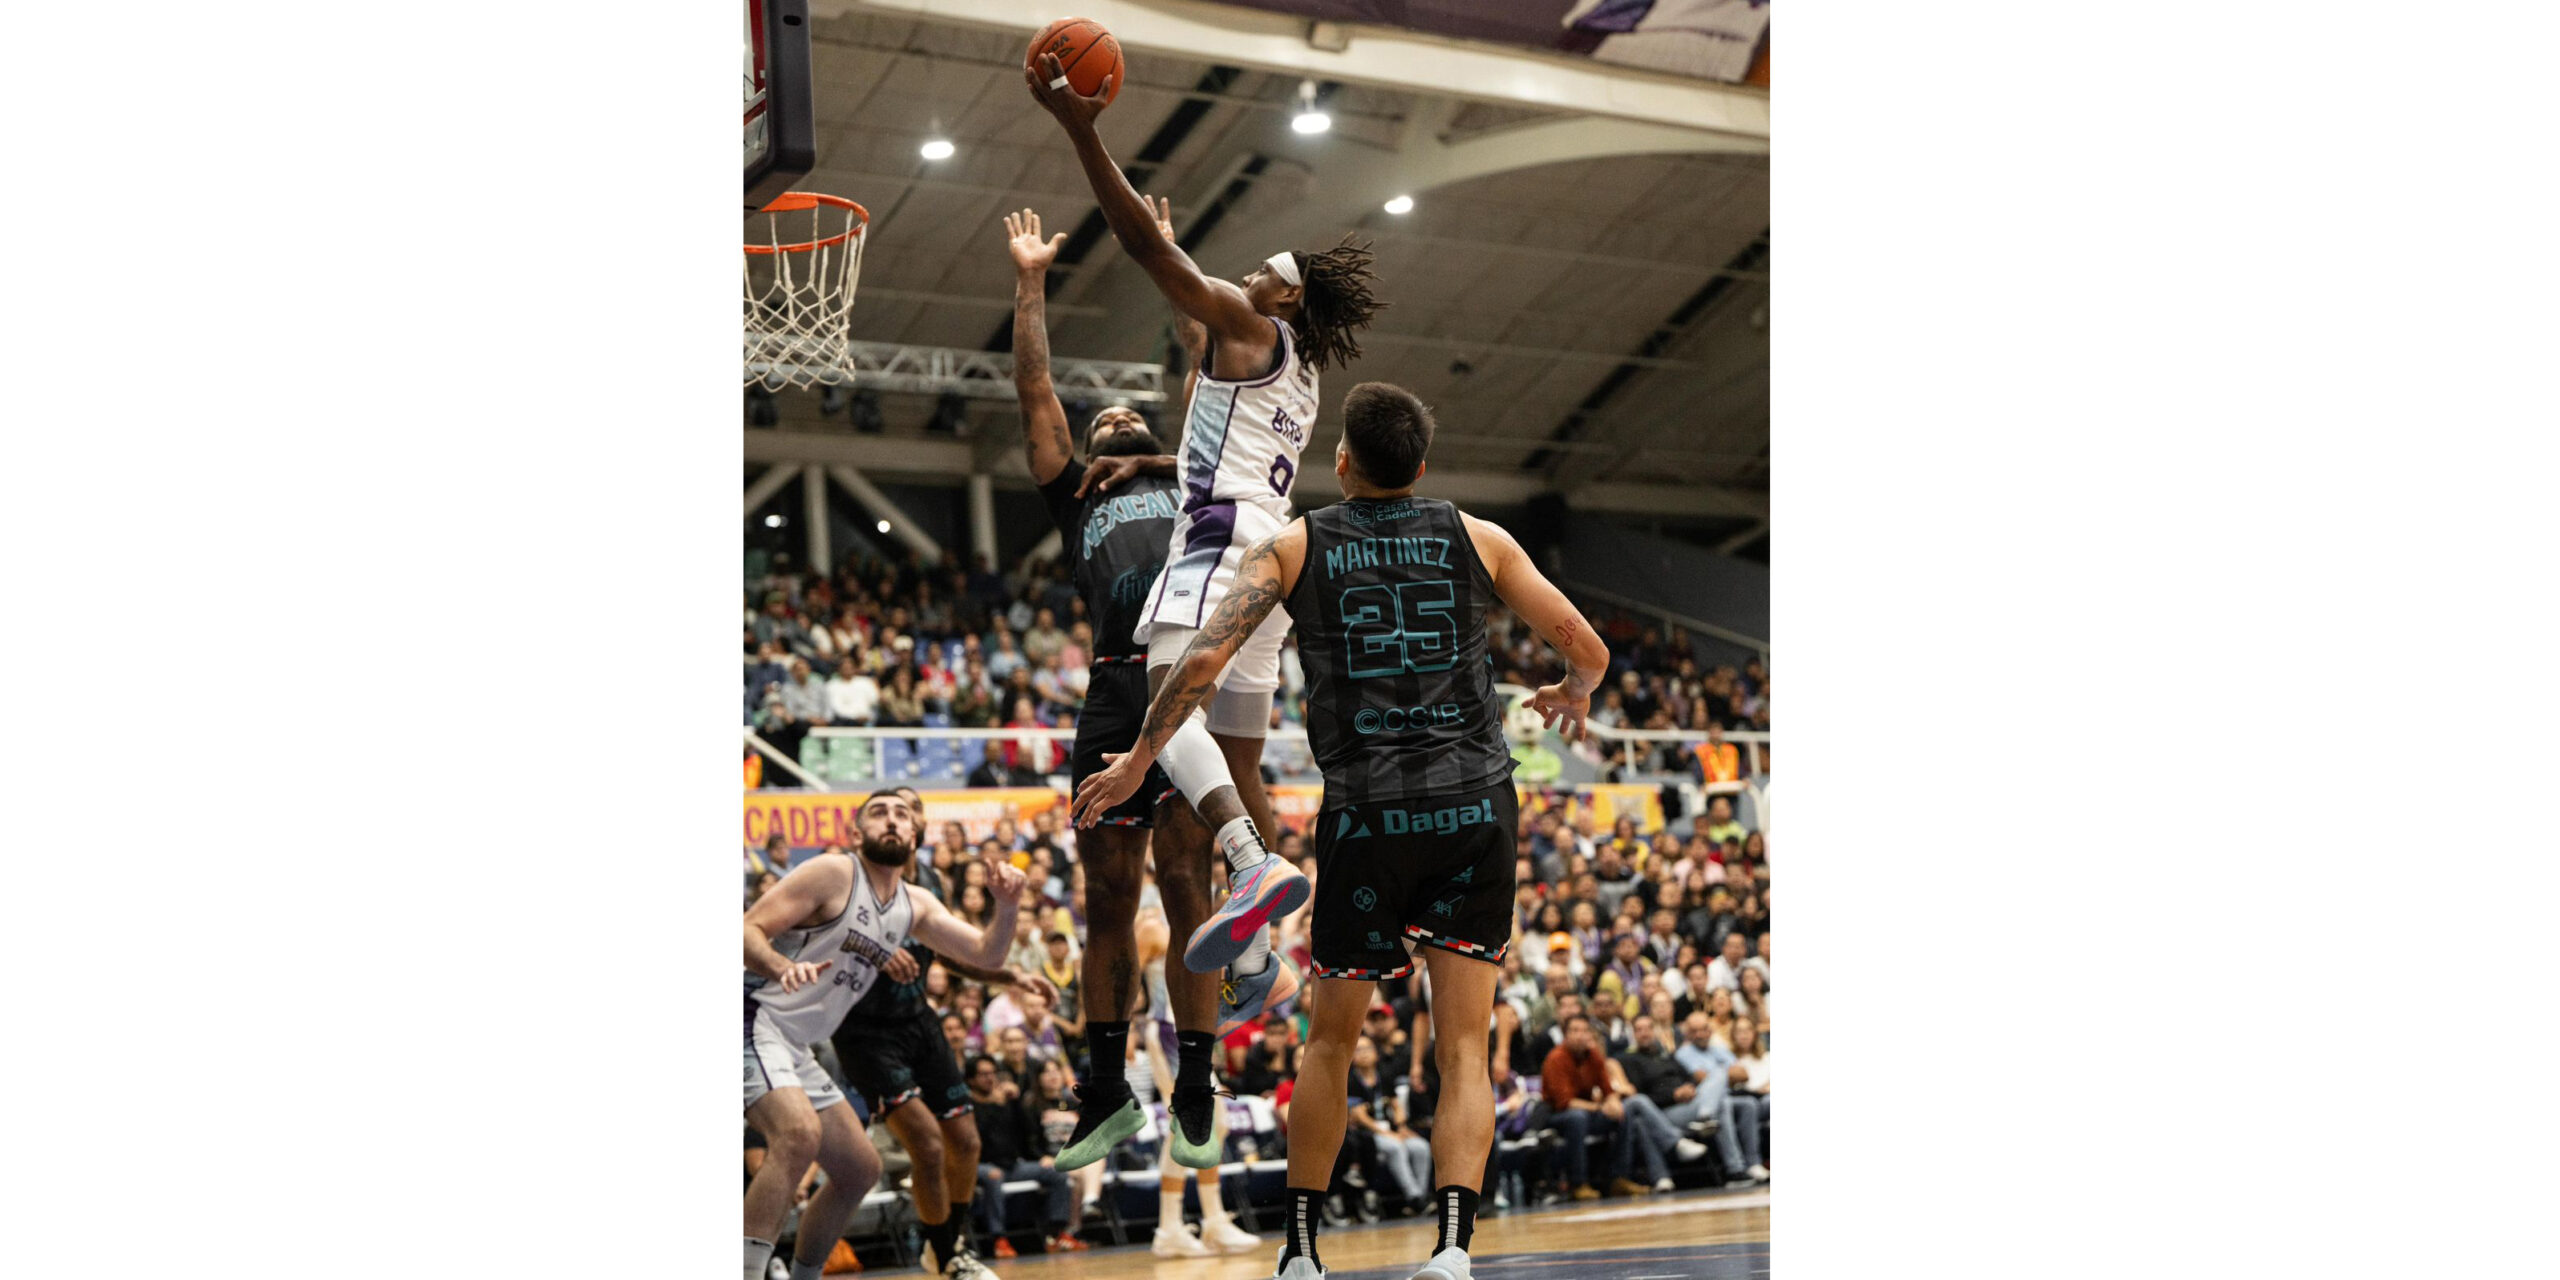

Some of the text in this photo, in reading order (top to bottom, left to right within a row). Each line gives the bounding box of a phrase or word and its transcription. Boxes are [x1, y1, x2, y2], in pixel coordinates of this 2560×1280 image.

[1269, 454, 1293, 497] 0
[1375, 501, 1411, 513] Casas
[1376, 508, 1421, 521] Cadena
[1326, 537, 1455, 580] MARTINEZ
[1339, 579, 1460, 680] 25
[1382, 797, 1493, 836] Dagal
